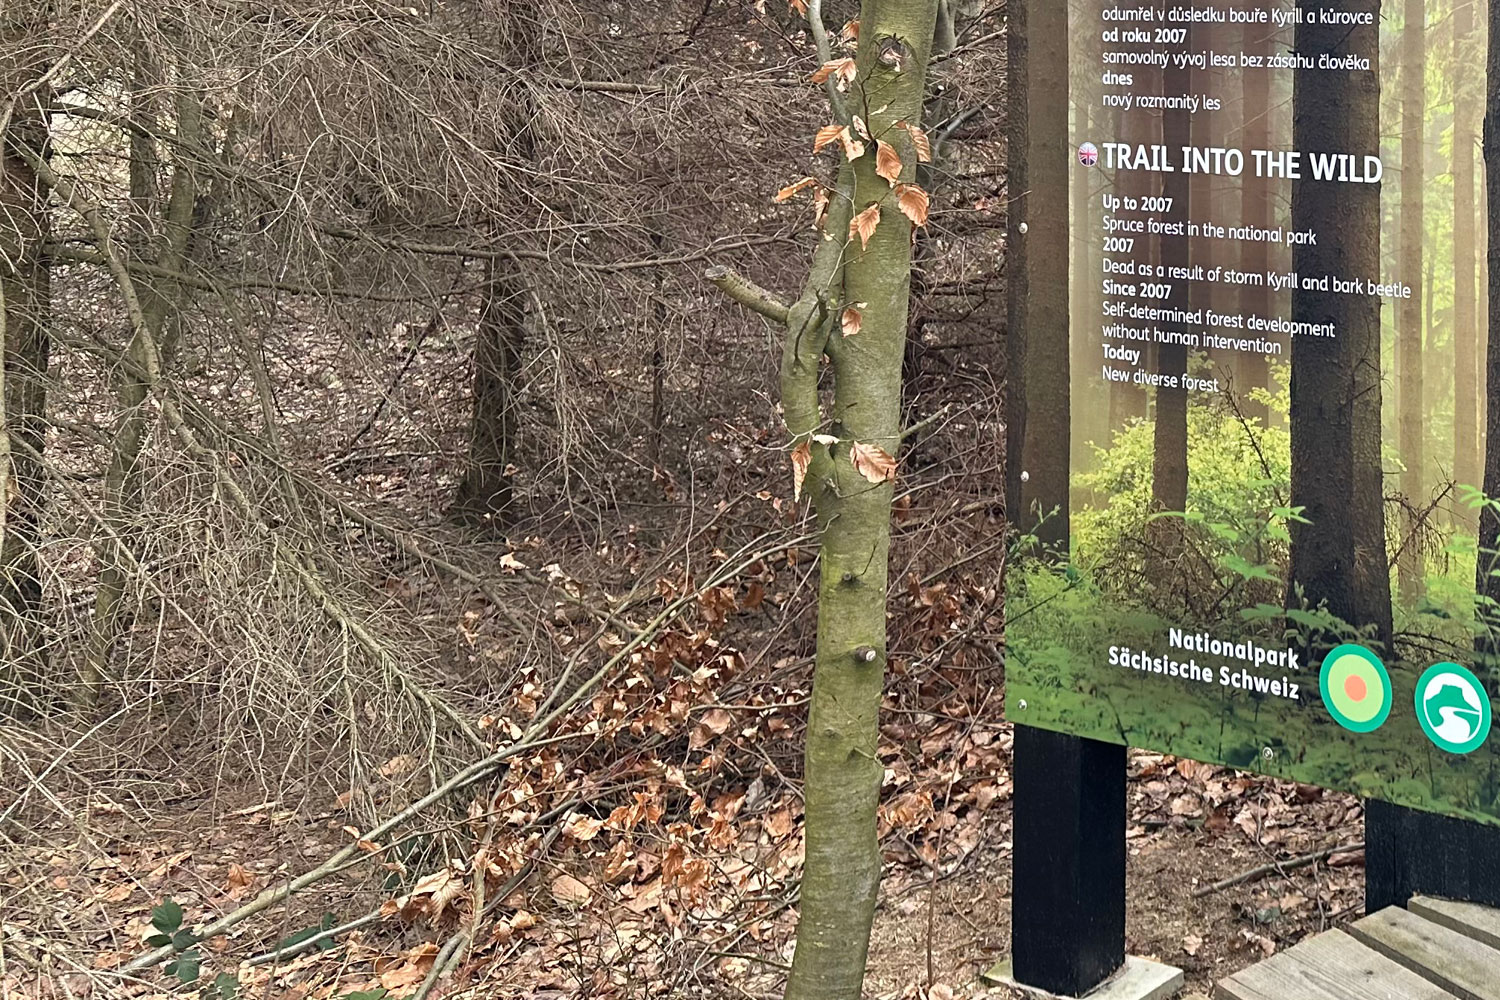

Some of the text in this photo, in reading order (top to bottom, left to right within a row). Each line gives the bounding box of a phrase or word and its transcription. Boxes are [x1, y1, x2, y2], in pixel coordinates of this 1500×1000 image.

[1102, 6, 1373, 27] odumřel v důsledku bouře Kyrill a kůrovce
[1102, 27, 1187, 43] od roku 2007
[1102, 49, 1370, 70] samovolný vývoj lesa bez zásahu člověka
[1102, 70, 1133, 85] dnes
[1102, 92, 1221, 113] nový rozmanitý les
[1102, 142, 1383, 184] TRAIL INTO THE WILD
[1102, 194, 1173, 212] Up to 2007
[1102, 215, 1317, 247] Spruce forest in the national park
[1103, 237, 1134, 253] 2007
[1102, 258, 1411, 299] Dead as a result of storm Kyrill and bark beetle
[1102, 279, 1172, 299] Since 2007
[1102, 301, 1336, 338] Self-determined forest development
[1102, 323, 1281, 354] without human intervention
[1102, 344, 1140, 365] Today
[1102, 365, 1219, 392] New diverse forest
[1169, 627, 1299, 670] Nationalpark
[1108, 646, 1299, 700] Sächsische Schweiz
